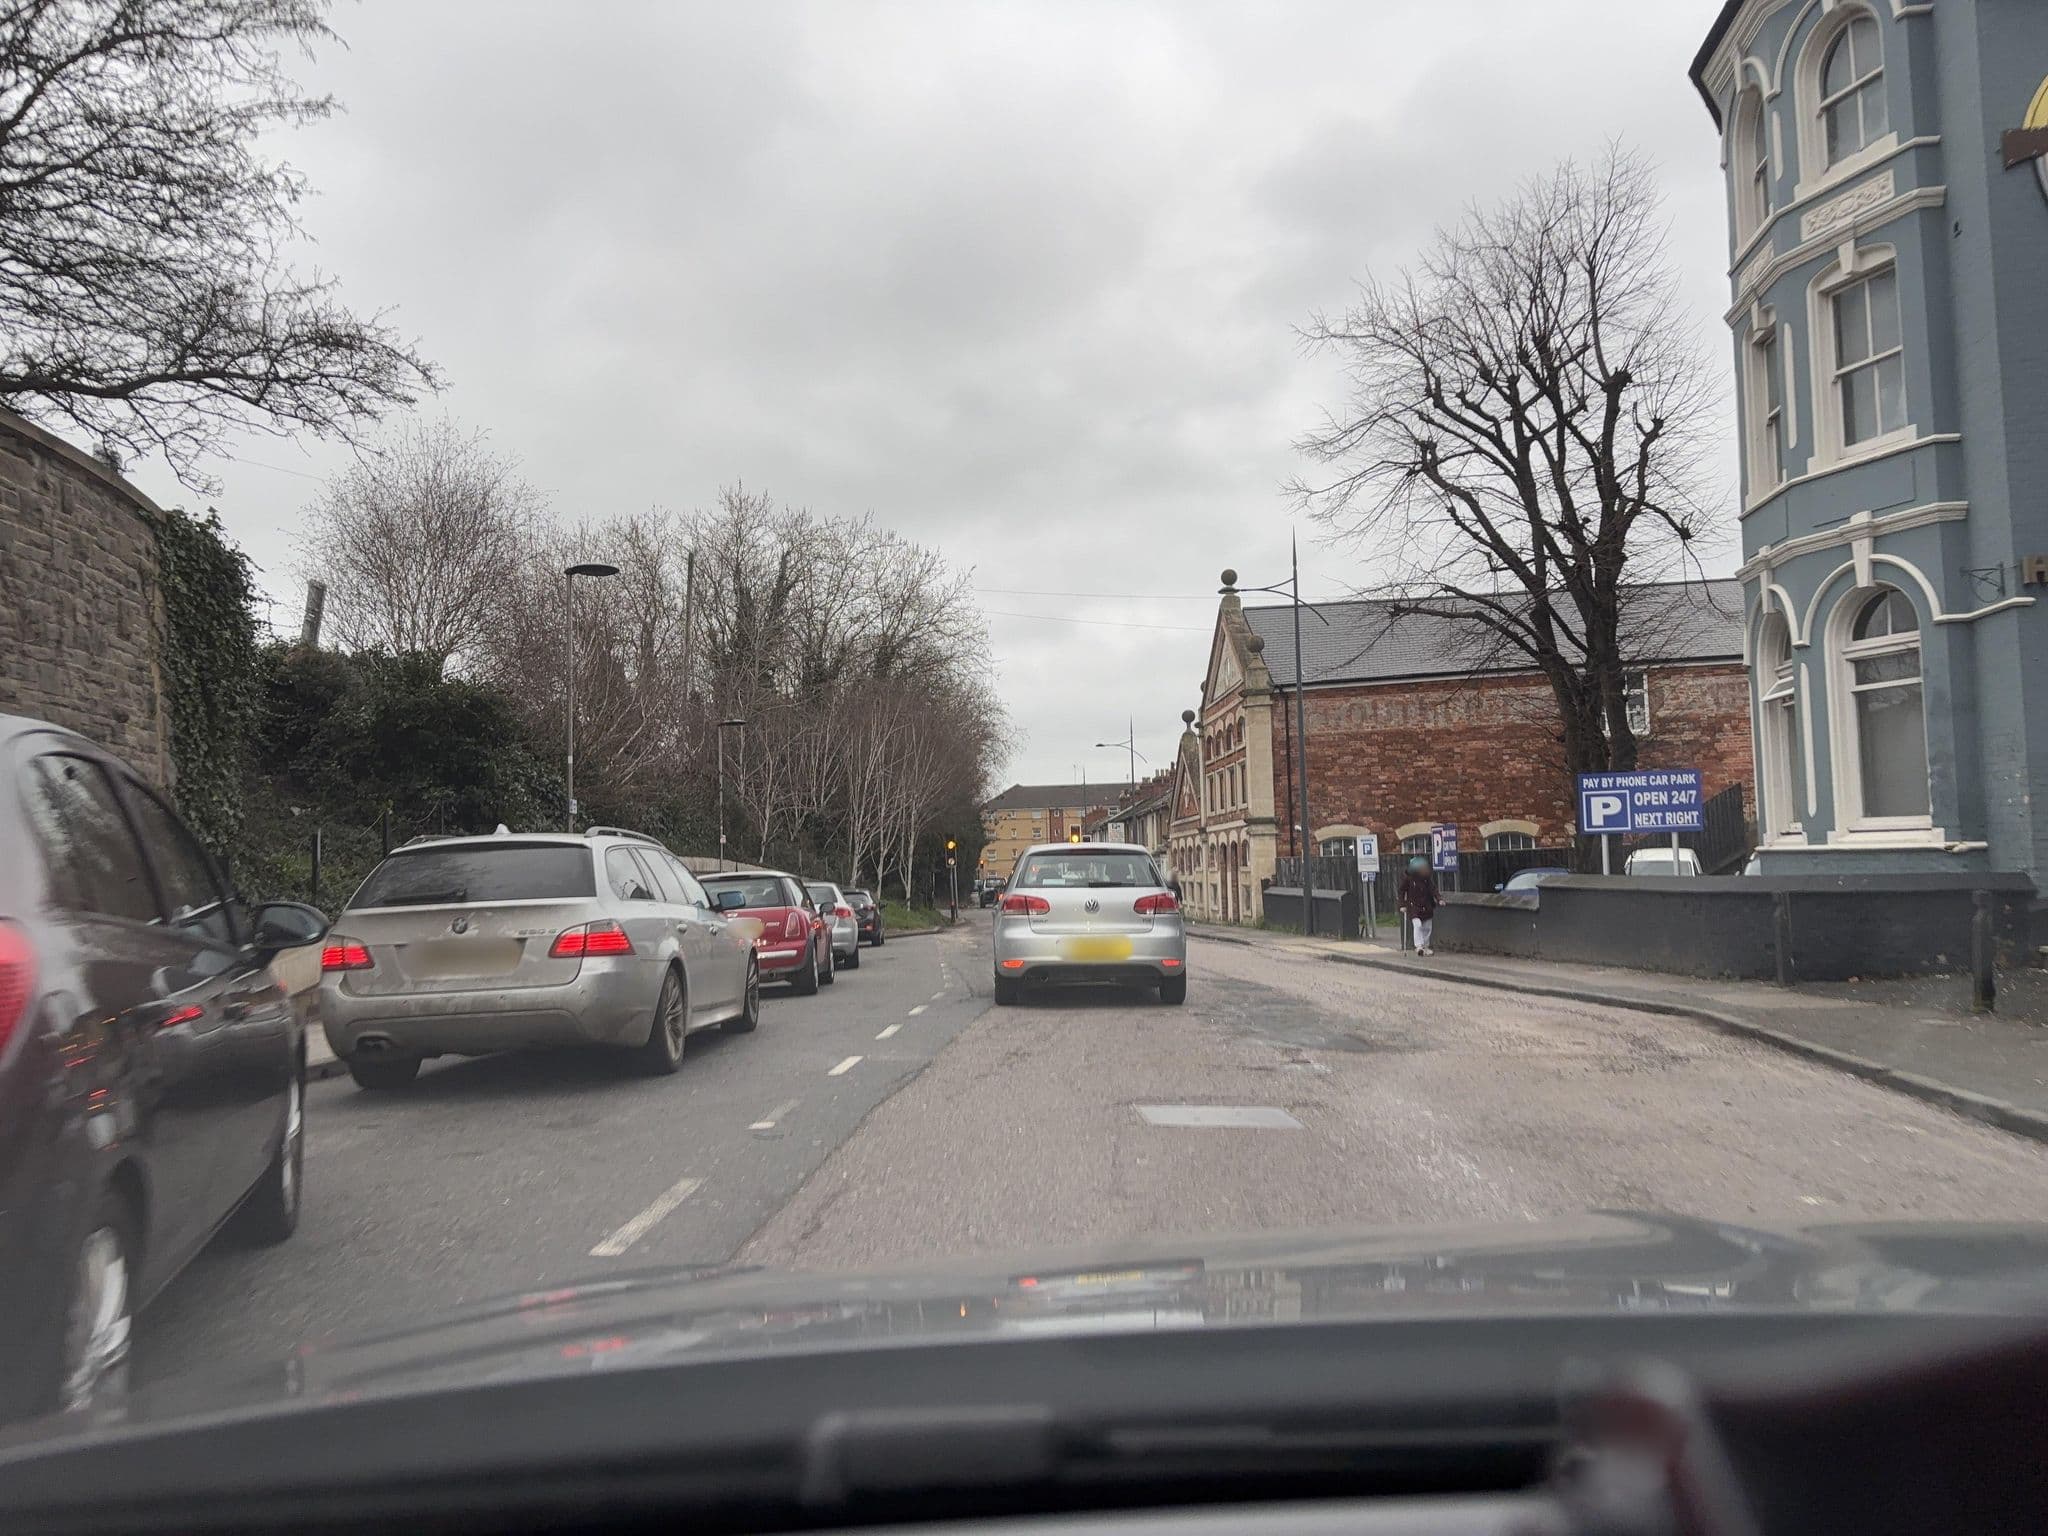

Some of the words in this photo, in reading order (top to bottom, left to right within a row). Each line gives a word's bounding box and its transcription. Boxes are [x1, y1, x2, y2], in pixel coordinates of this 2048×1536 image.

[1583, 778, 1598, 789] PAY
[1601, 777, 1614, 788] BY
[1616, 776, 1647, 787] PHONE
[1649, 775, 1669, 786] CAR
[1671, 774, 1696, 785] PARK
[1634, 792, 1668, 806] OPEN
[1671, 790, 1697, 804] 24/7
[1590, 796, 1622, 826] P
[1634, 812, 1663, 826] NEXT
[1666, 811, 1699, 824] RIGHT
[1434, 833, 1442, 865] P
